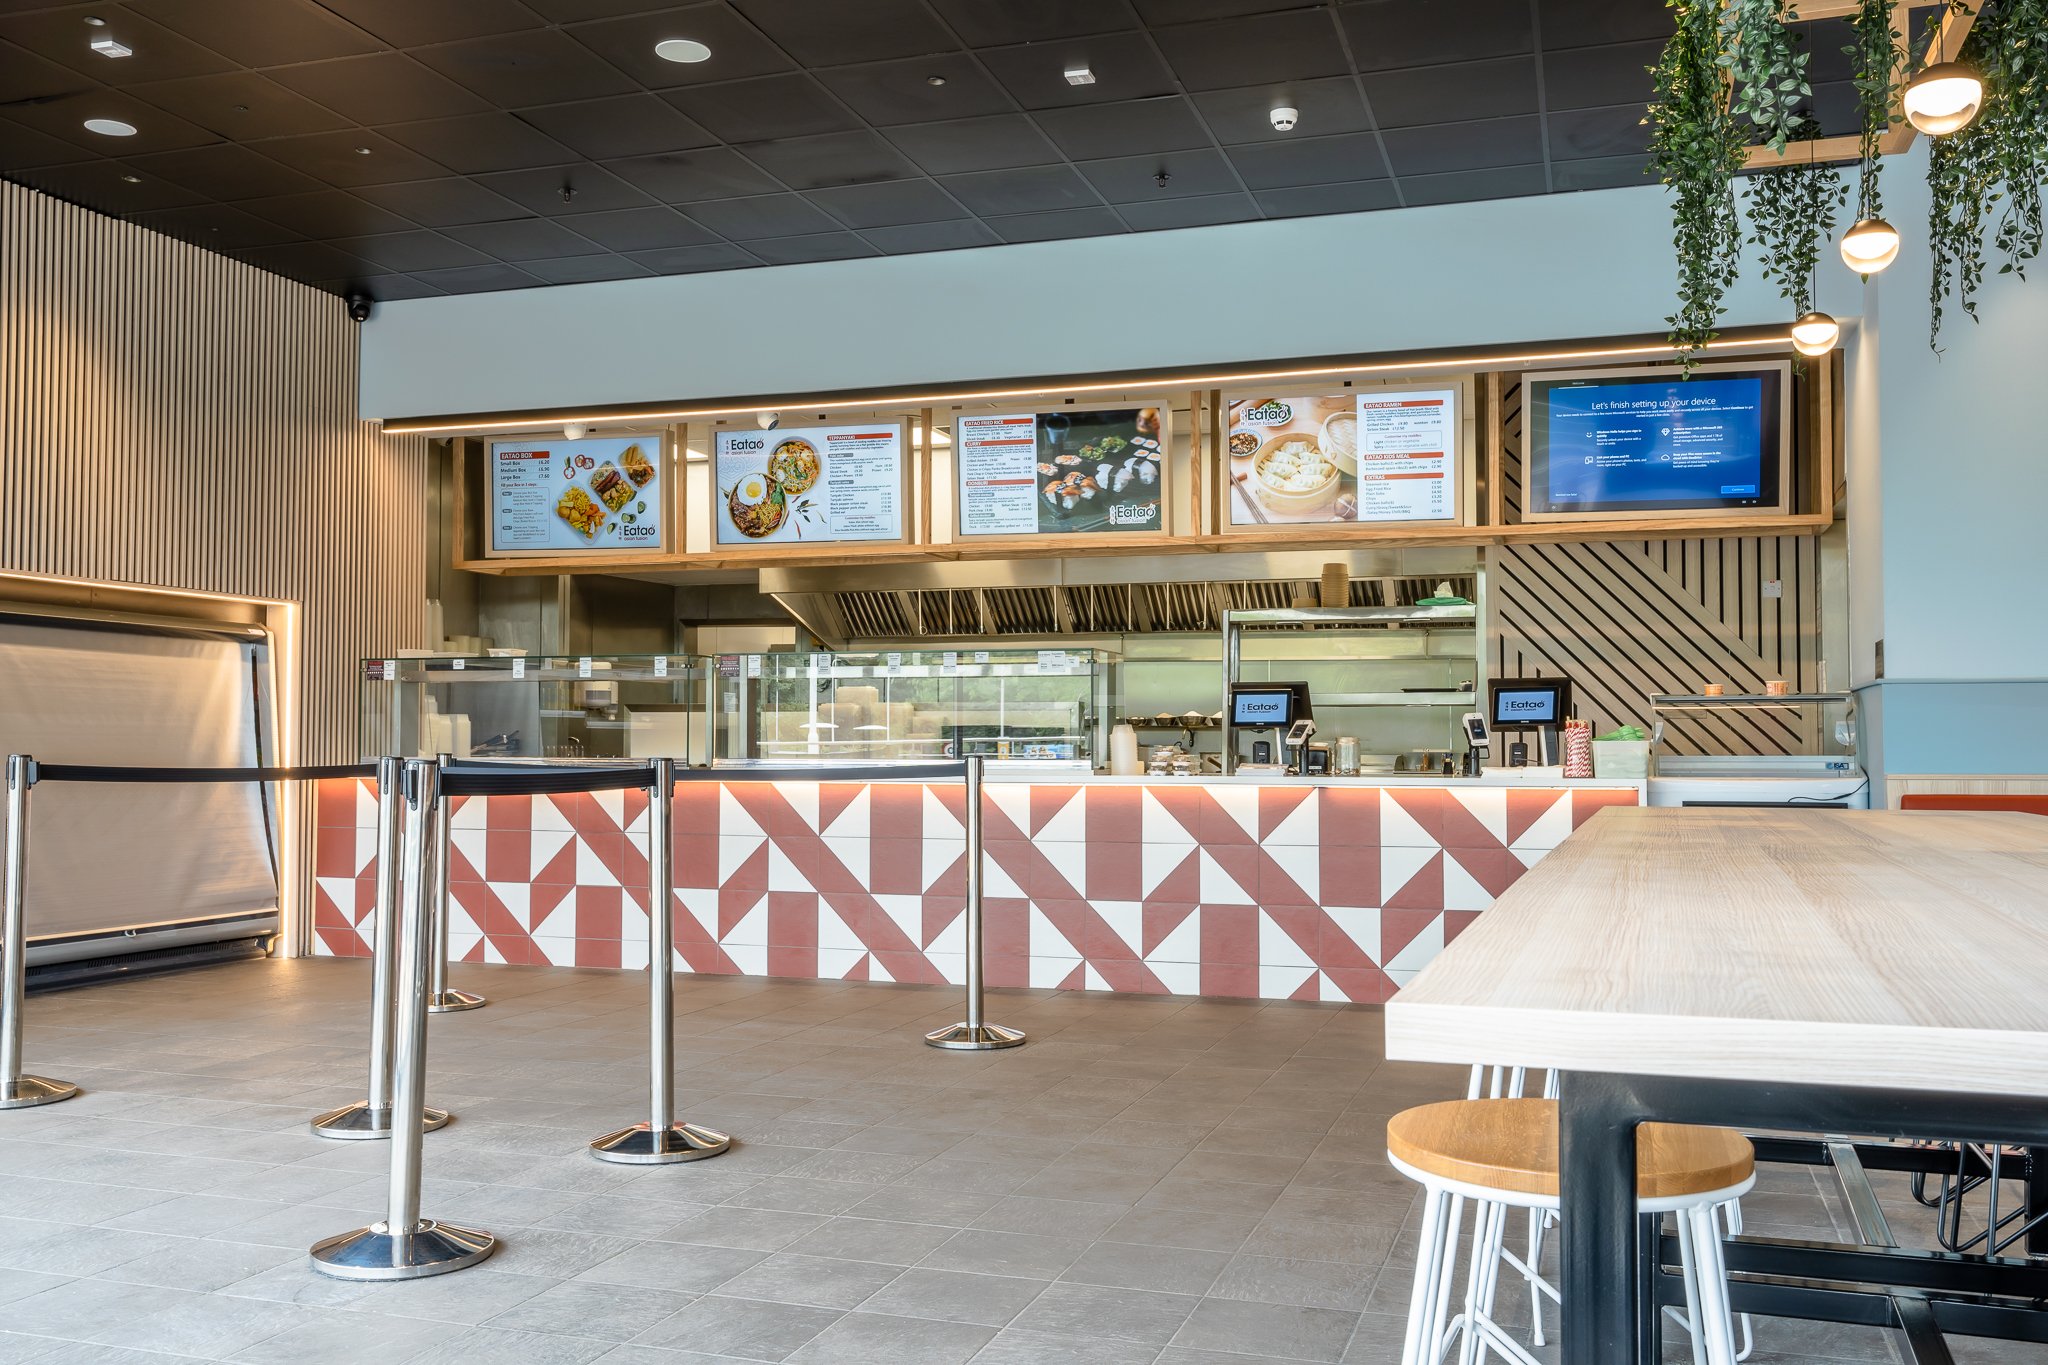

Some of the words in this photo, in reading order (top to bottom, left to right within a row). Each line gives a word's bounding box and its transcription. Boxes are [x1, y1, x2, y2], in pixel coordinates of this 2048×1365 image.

[1592, 402, 1608, 410] Let's
[1610, 401, 1629, 409] finish
[1632, 400, 1657, 409] setting
[1659, 400, 1669, 408] up
[1671, 400, 1689, 408] your
[1691, 397, 1716, 406] device
[1248, 407, 1287, 420] Eatao
[731, 438, 764, 450] Eatao
[1117, 504, 1155, 518] Eatao
[624, 524, 656, 536] Eatao
[1247, 703, 1279, 711] Eatao
[1511, 700, 1545, 709] Eatao
